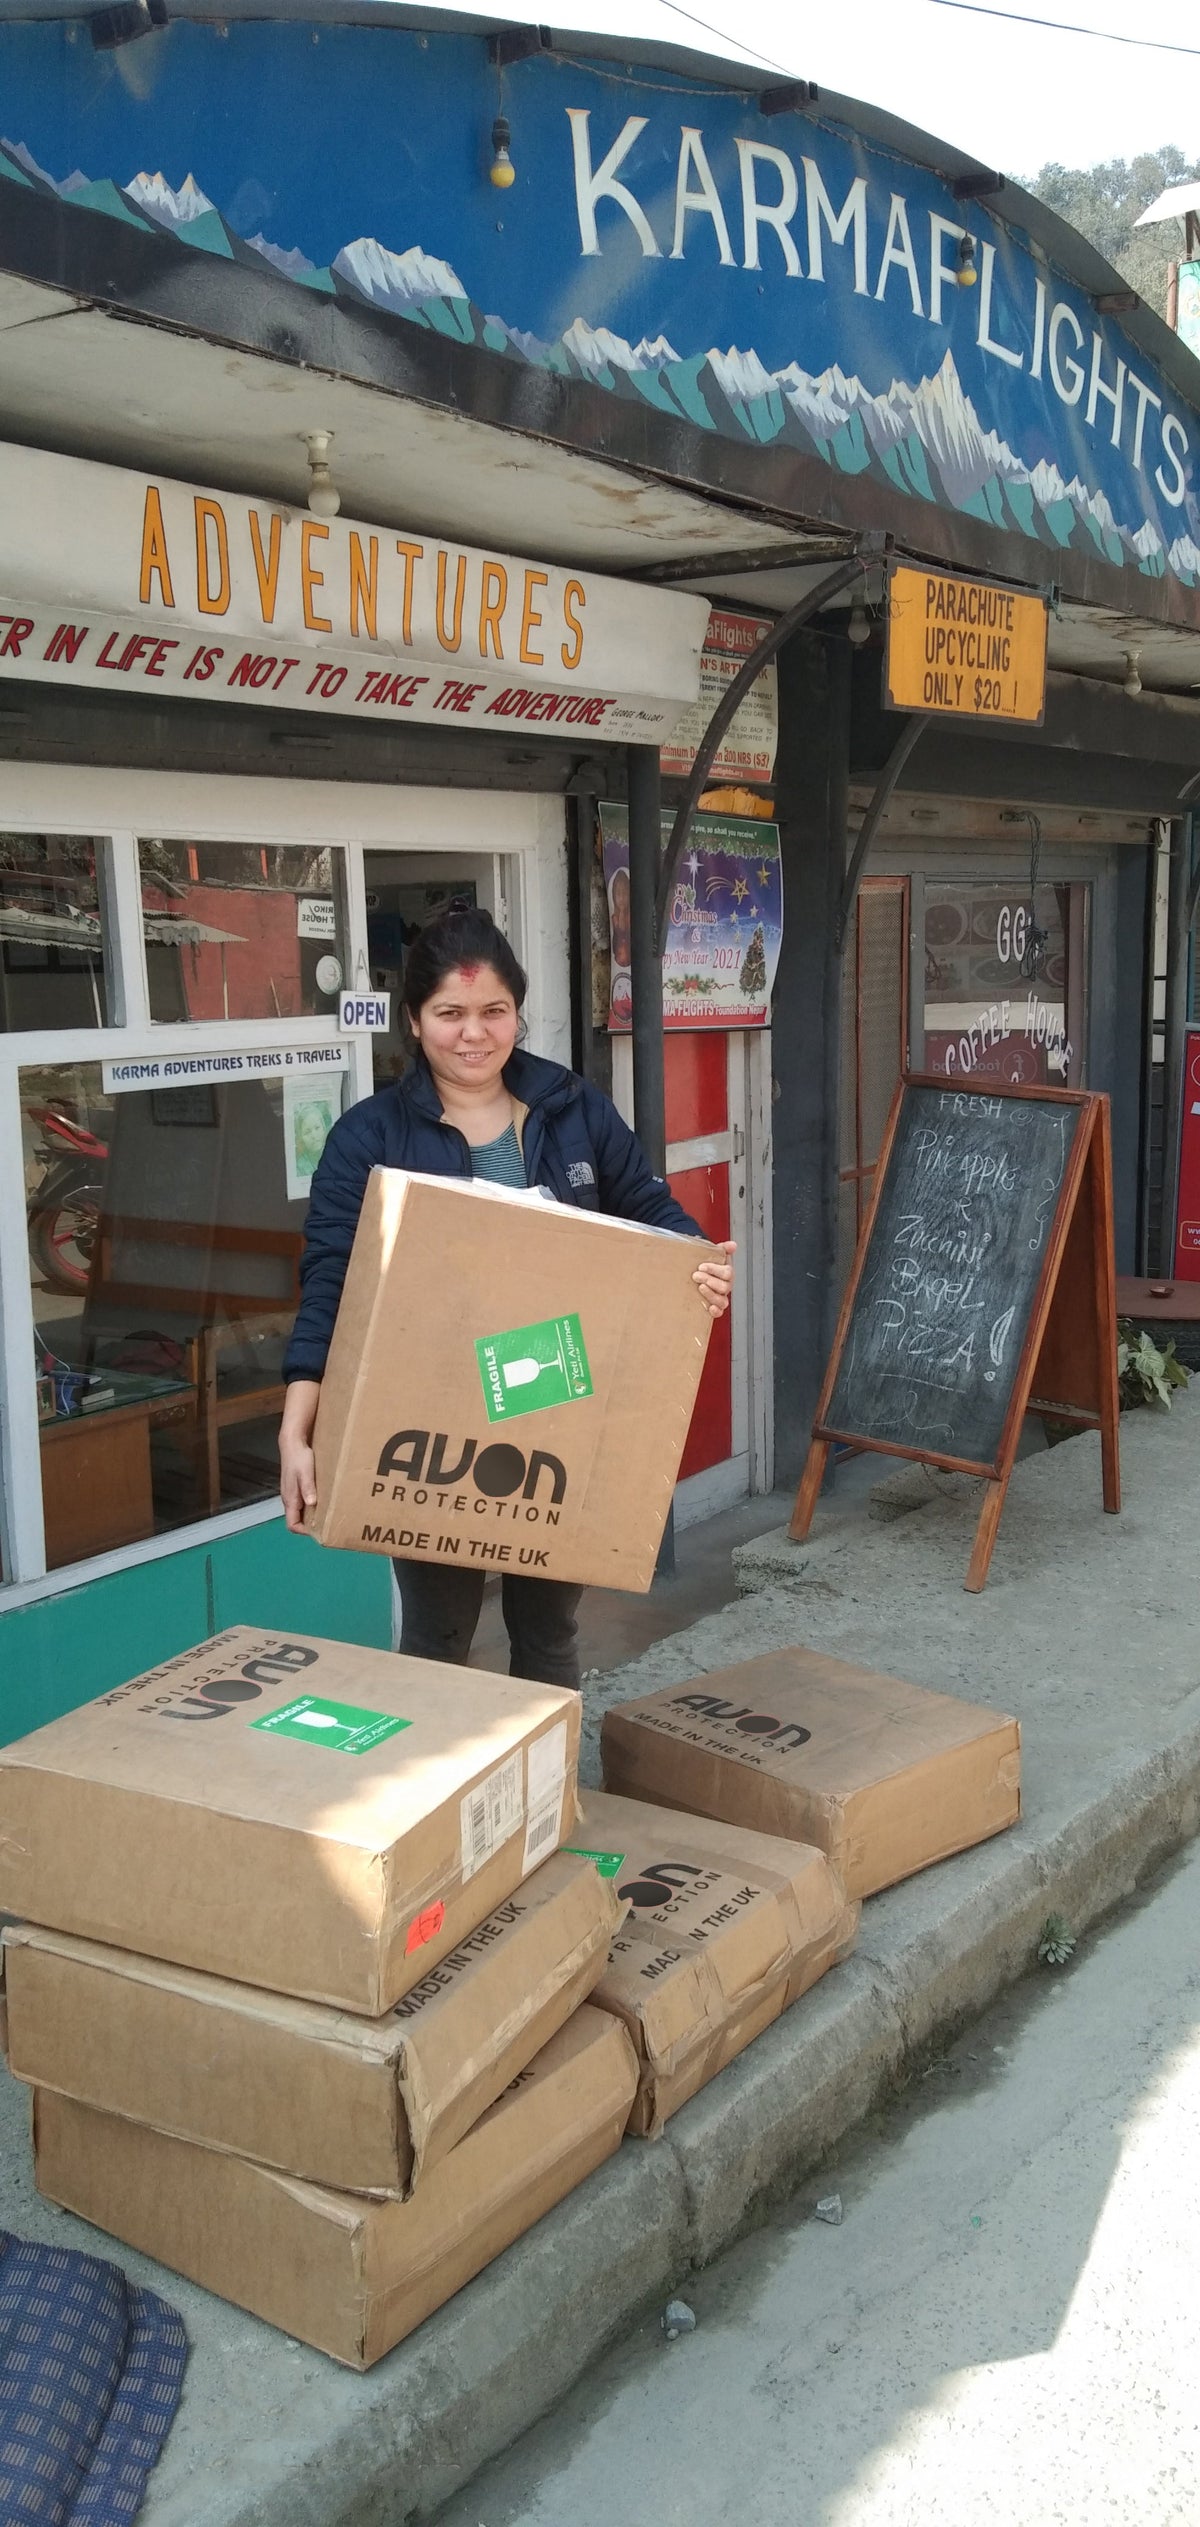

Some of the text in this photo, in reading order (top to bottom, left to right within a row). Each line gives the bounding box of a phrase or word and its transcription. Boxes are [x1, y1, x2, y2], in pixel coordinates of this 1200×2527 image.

[139, 485, 587, 669] ADVENTURES
[926, 578, 1015, 632] PARACHUTE
[707, 619, 754, 648] aFlights
[925, 626, 1011, 672] UPCYCLING
[43, 624, 90, 664] IN
[95, 632, 180, 677] LIFE
[183, 645, 224, 681] IS
[227, 653, 300, 692] NOT
[305, 663, 348, 698] TO
[354, 671, 430, 707] TAKE
[432, 680, 487, 713] THE
[484, 688, 617, 726] ADVENTURE
[700, 658, 718, 671] N'S
[923, 671, 963, 706] ONLY
[671, 896, 718, 925] Christmas
[344, 1001, 385, 1026] OPEN
[1024, 990, 1073, 1079] HOUSE
[112, 1048, 342, 1081] KARMA ADVENTURES TREKS & TRAVELS
[938, 1093, 1004, 1119] FRESH
[563, 1319, 580, 1380] Yeti Airlines
[484, 1346, 506, 1413] FRAGILE
[371, 1482, 560, 1526] PROTECTION
[361, 1524, 550, 1567] MADE IN THE UK
[95, 1634, 239, 1707] MADE IN THE UK
[137, 1639, 278, 1714] PROTECTION
[262, 1699, 316, 1728] FRAGILE
[634, 1713, 768, 1765] MADE IN THE UK
[658, 1702, 790, 1754] PROTECTION
[640, 1886, 761, 1979] MAD N THE UK
[393, 1971, 453, 2018] MADE
[444, 1953, 473, 1972] IN
[462, 1923, 504, 1953] THE
[494, 1901, 527, 1925] UK
